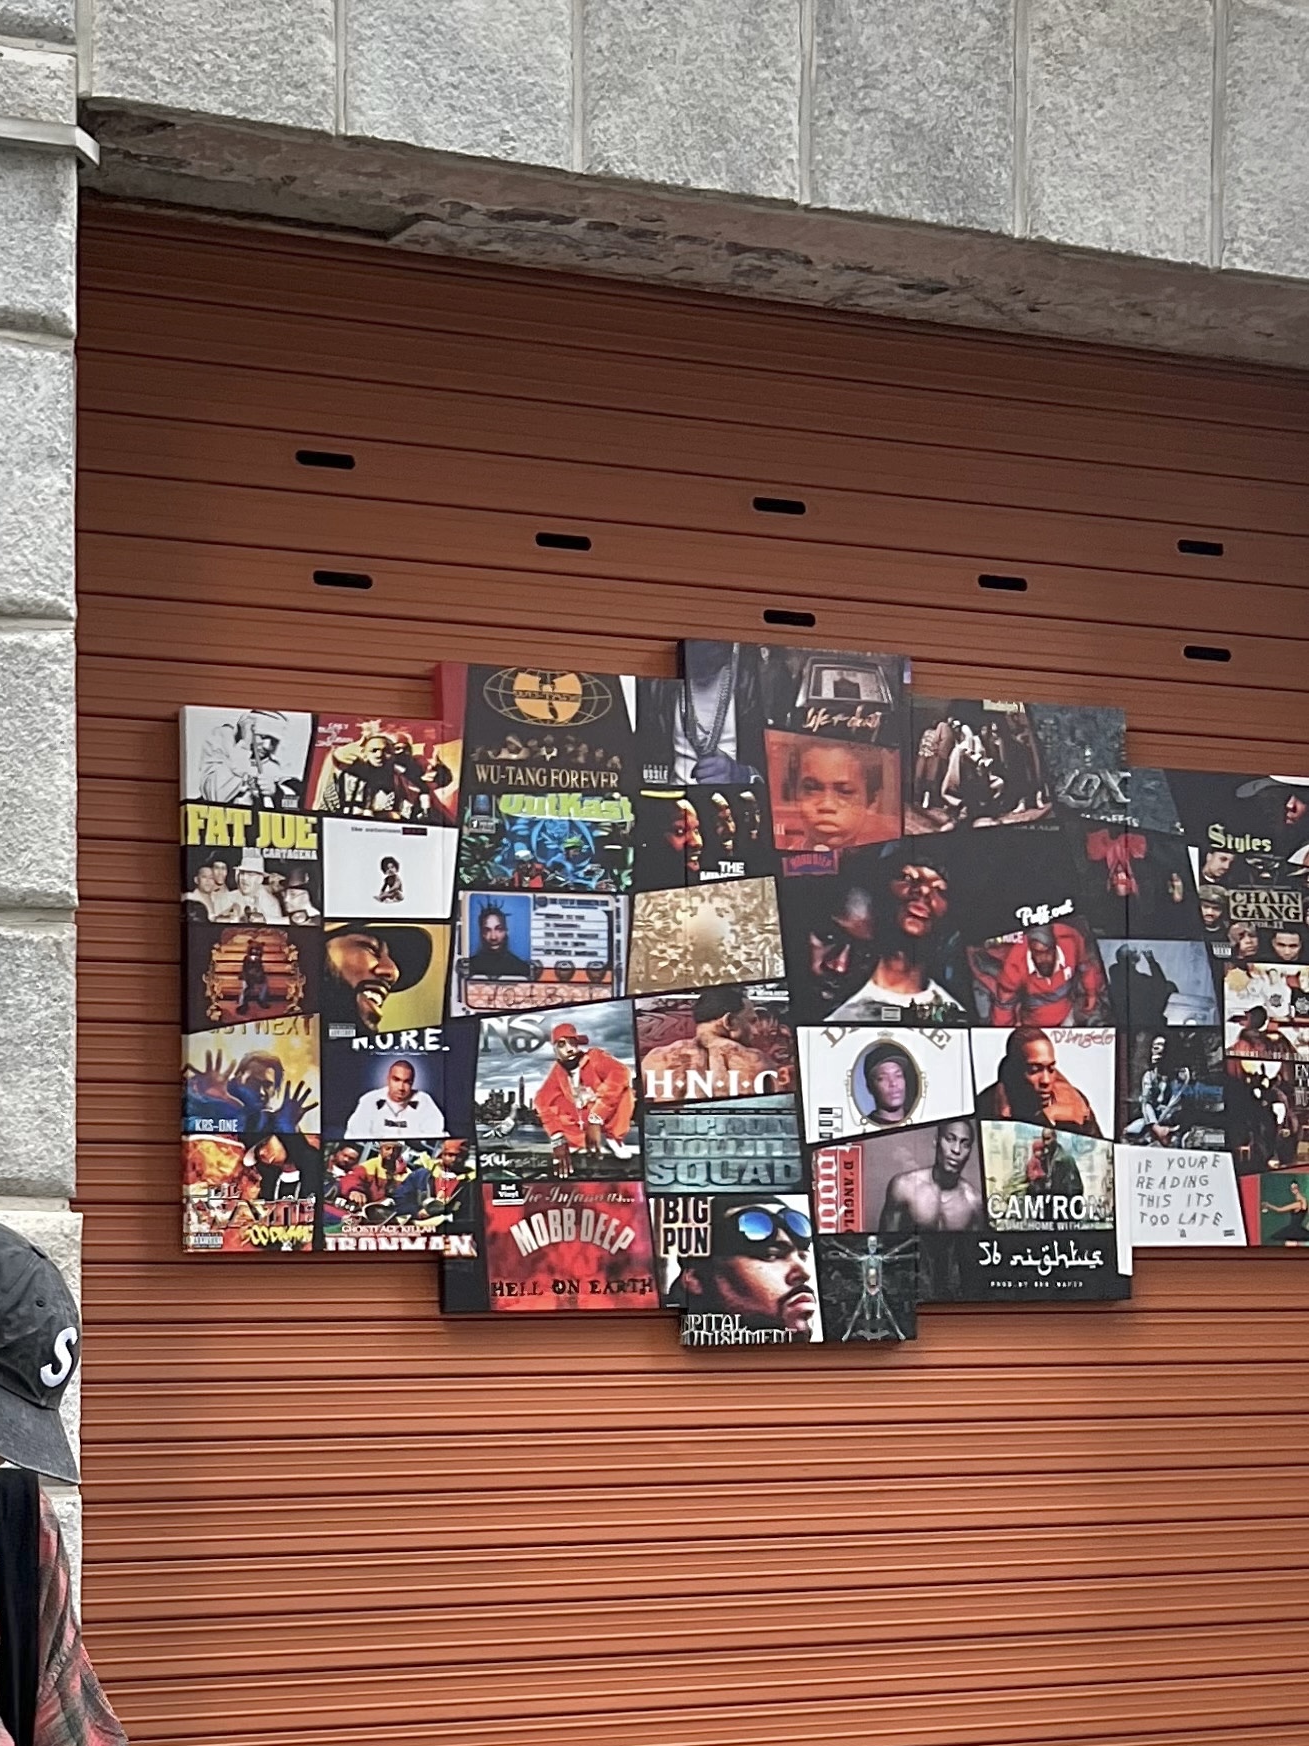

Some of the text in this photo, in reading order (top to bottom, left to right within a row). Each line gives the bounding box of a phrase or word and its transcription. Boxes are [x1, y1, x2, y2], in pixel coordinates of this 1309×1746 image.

[475, 763, 619, 788] WU-TANG FOREVER
[186, 803, 251, 847] FAT
[1208, 823, 1272, 853] Styles
[718, 861, 745, 874] THE
[1231, 891, 1299, 905] CHAIN
[1231, 904, 1301, 920] GANG
[252, 1014, 314, 1036] NEXT
[1050, 1028, 1116, 1049] D'Angelo
[194, 1118, 239, 1133] KRS-ONE
[647, 1159, 803, 1187] SQUAD
[1137, 1154, 1221, 1174] IF YOURE
[1136, 1175, 1210, 1190] READING
[662, 1196, 710, 1225] BIG
[1137, 1193, 1215, 1209] THIS ITS
[400, 1225, 437, 1233] KILLAH
[1139, 1211, 1223, 1227] TOO LATE
[509, 1207, 636, 1257] MOBB DEEP
[662, 1227, 709, 1255] PUN
[324, 1234, 478, 1257] IRONMAN
[491, 1277, 655, 1297] HELL ON EARTH
[39, 1326, 79, 1388] S
